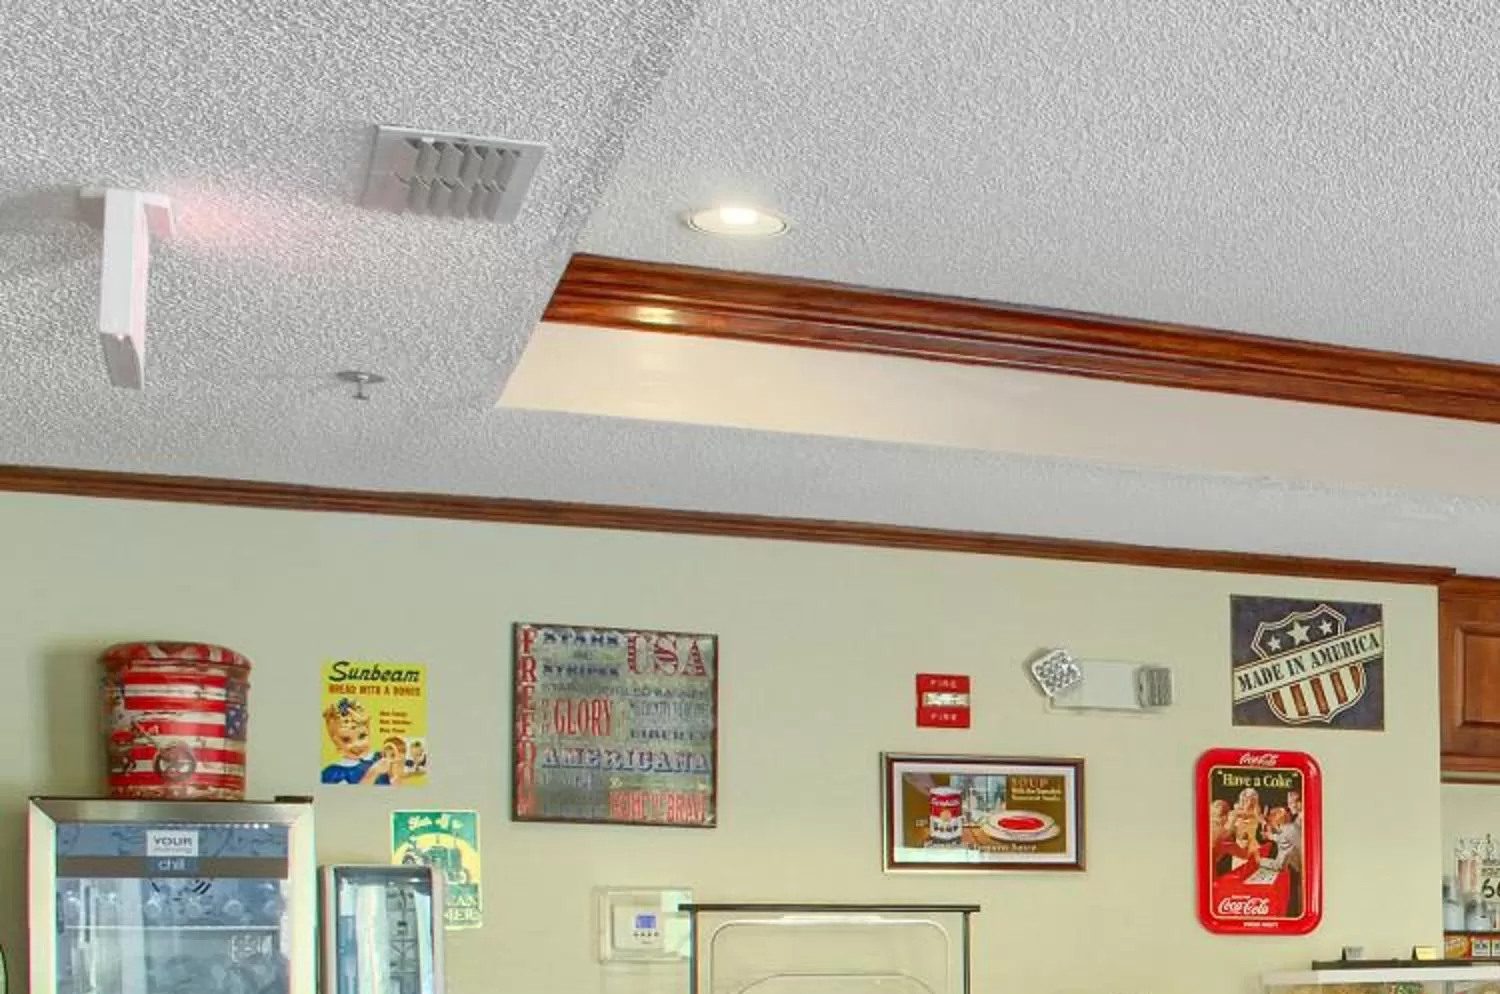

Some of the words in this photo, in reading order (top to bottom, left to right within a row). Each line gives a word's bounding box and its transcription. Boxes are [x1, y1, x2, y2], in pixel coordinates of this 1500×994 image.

[328, 661, 420, 682] Sunbeam
[627, 632, 708, 676] USA
[1238, 664, 1284, 692] MADE
[1286, 656, 1306, 677] IN
[1310, 632, 1380, 669] AMERICA
[554, 698, 612, 737] GLORY
